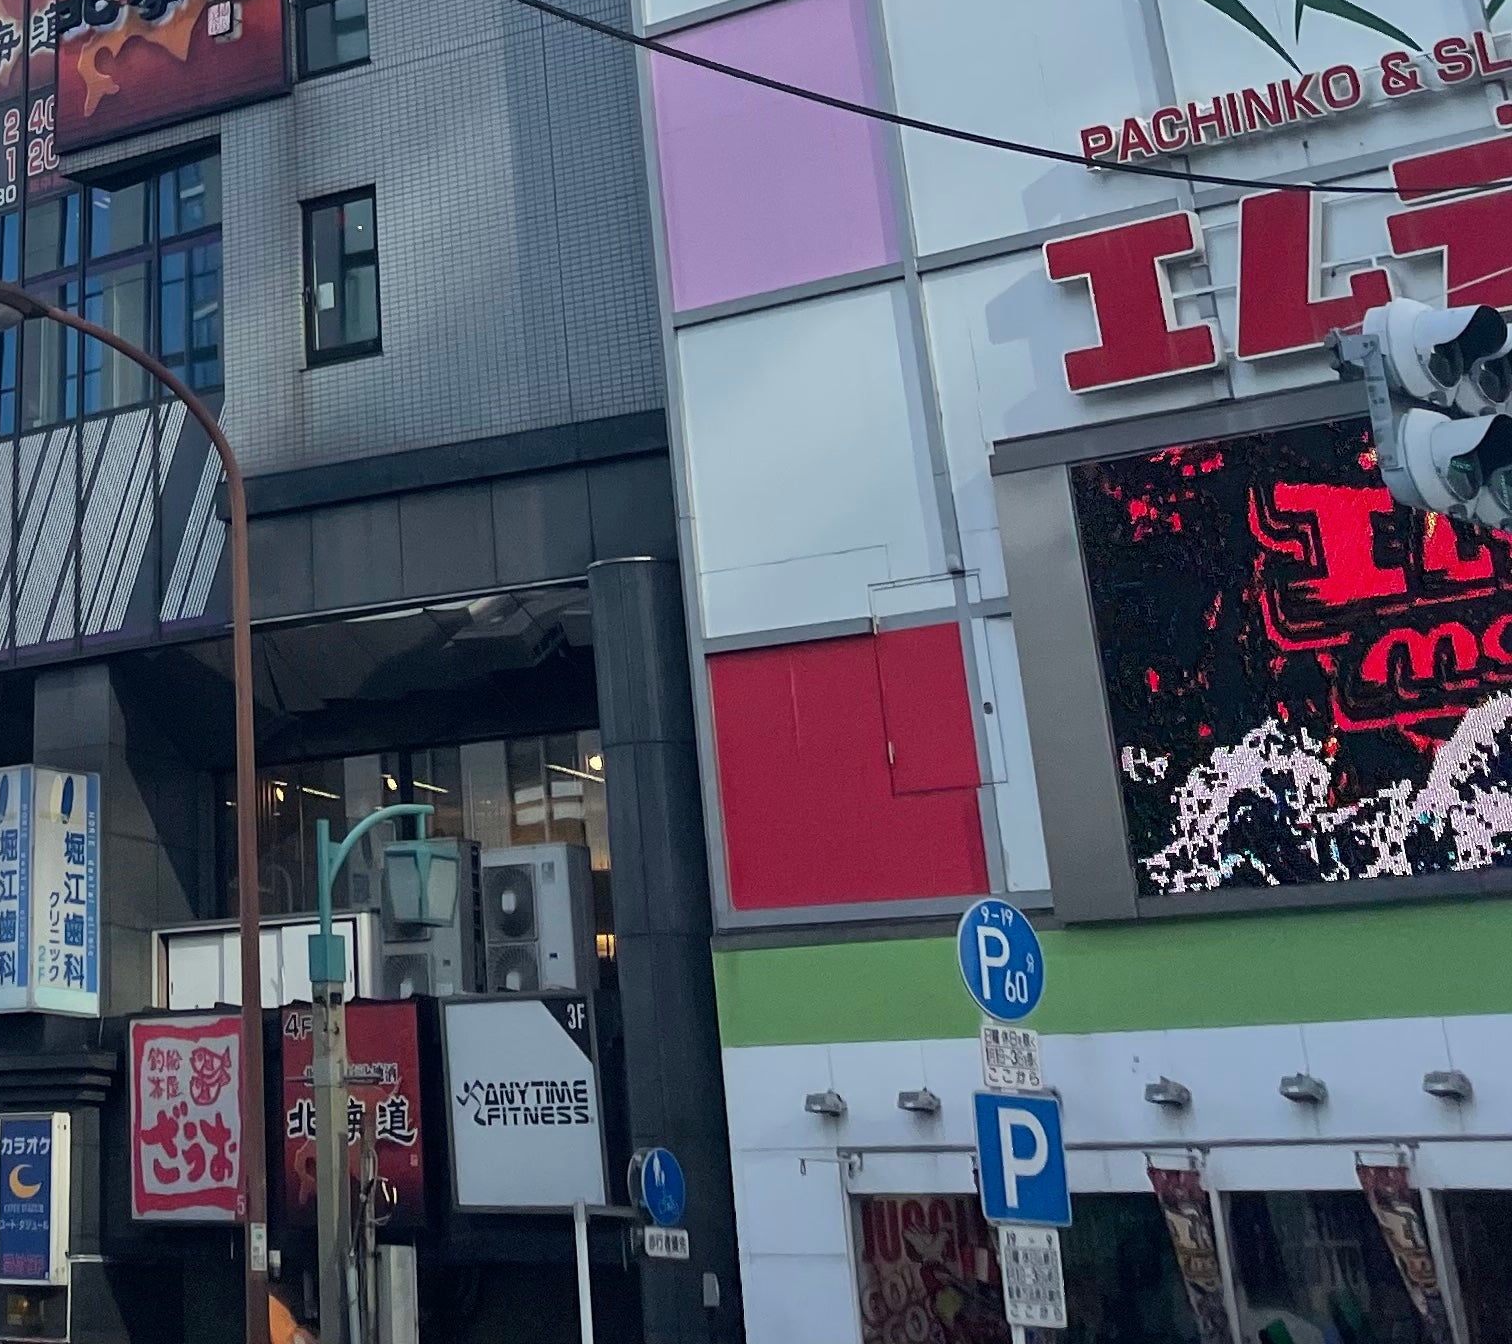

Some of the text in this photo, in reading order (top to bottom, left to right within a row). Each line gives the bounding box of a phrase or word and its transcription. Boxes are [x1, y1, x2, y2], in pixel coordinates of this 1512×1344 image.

[1081, 64, 1362, 164] PACHINKO
[1380, 50, 1422, 97] &
[63, 830, 86, 989] 堀江歯科
[49, 891, 60, 982] クリニック
[976, 925, 1011, 1001] P
[283, 1012, 314, 1041] 4F
[567, 1002, 586, 1031] 3F
[484, 1080, 589, 1106] ANYTIME
[988, 1067, 1040, 1087] ここから
[487, 1105, 590, 1126] FITNESS
[1, 1136, 50, 1156] カラオケ
[141, 1100, 238, 1186] ざうお
[997, 1106, 1050, 1210] P
